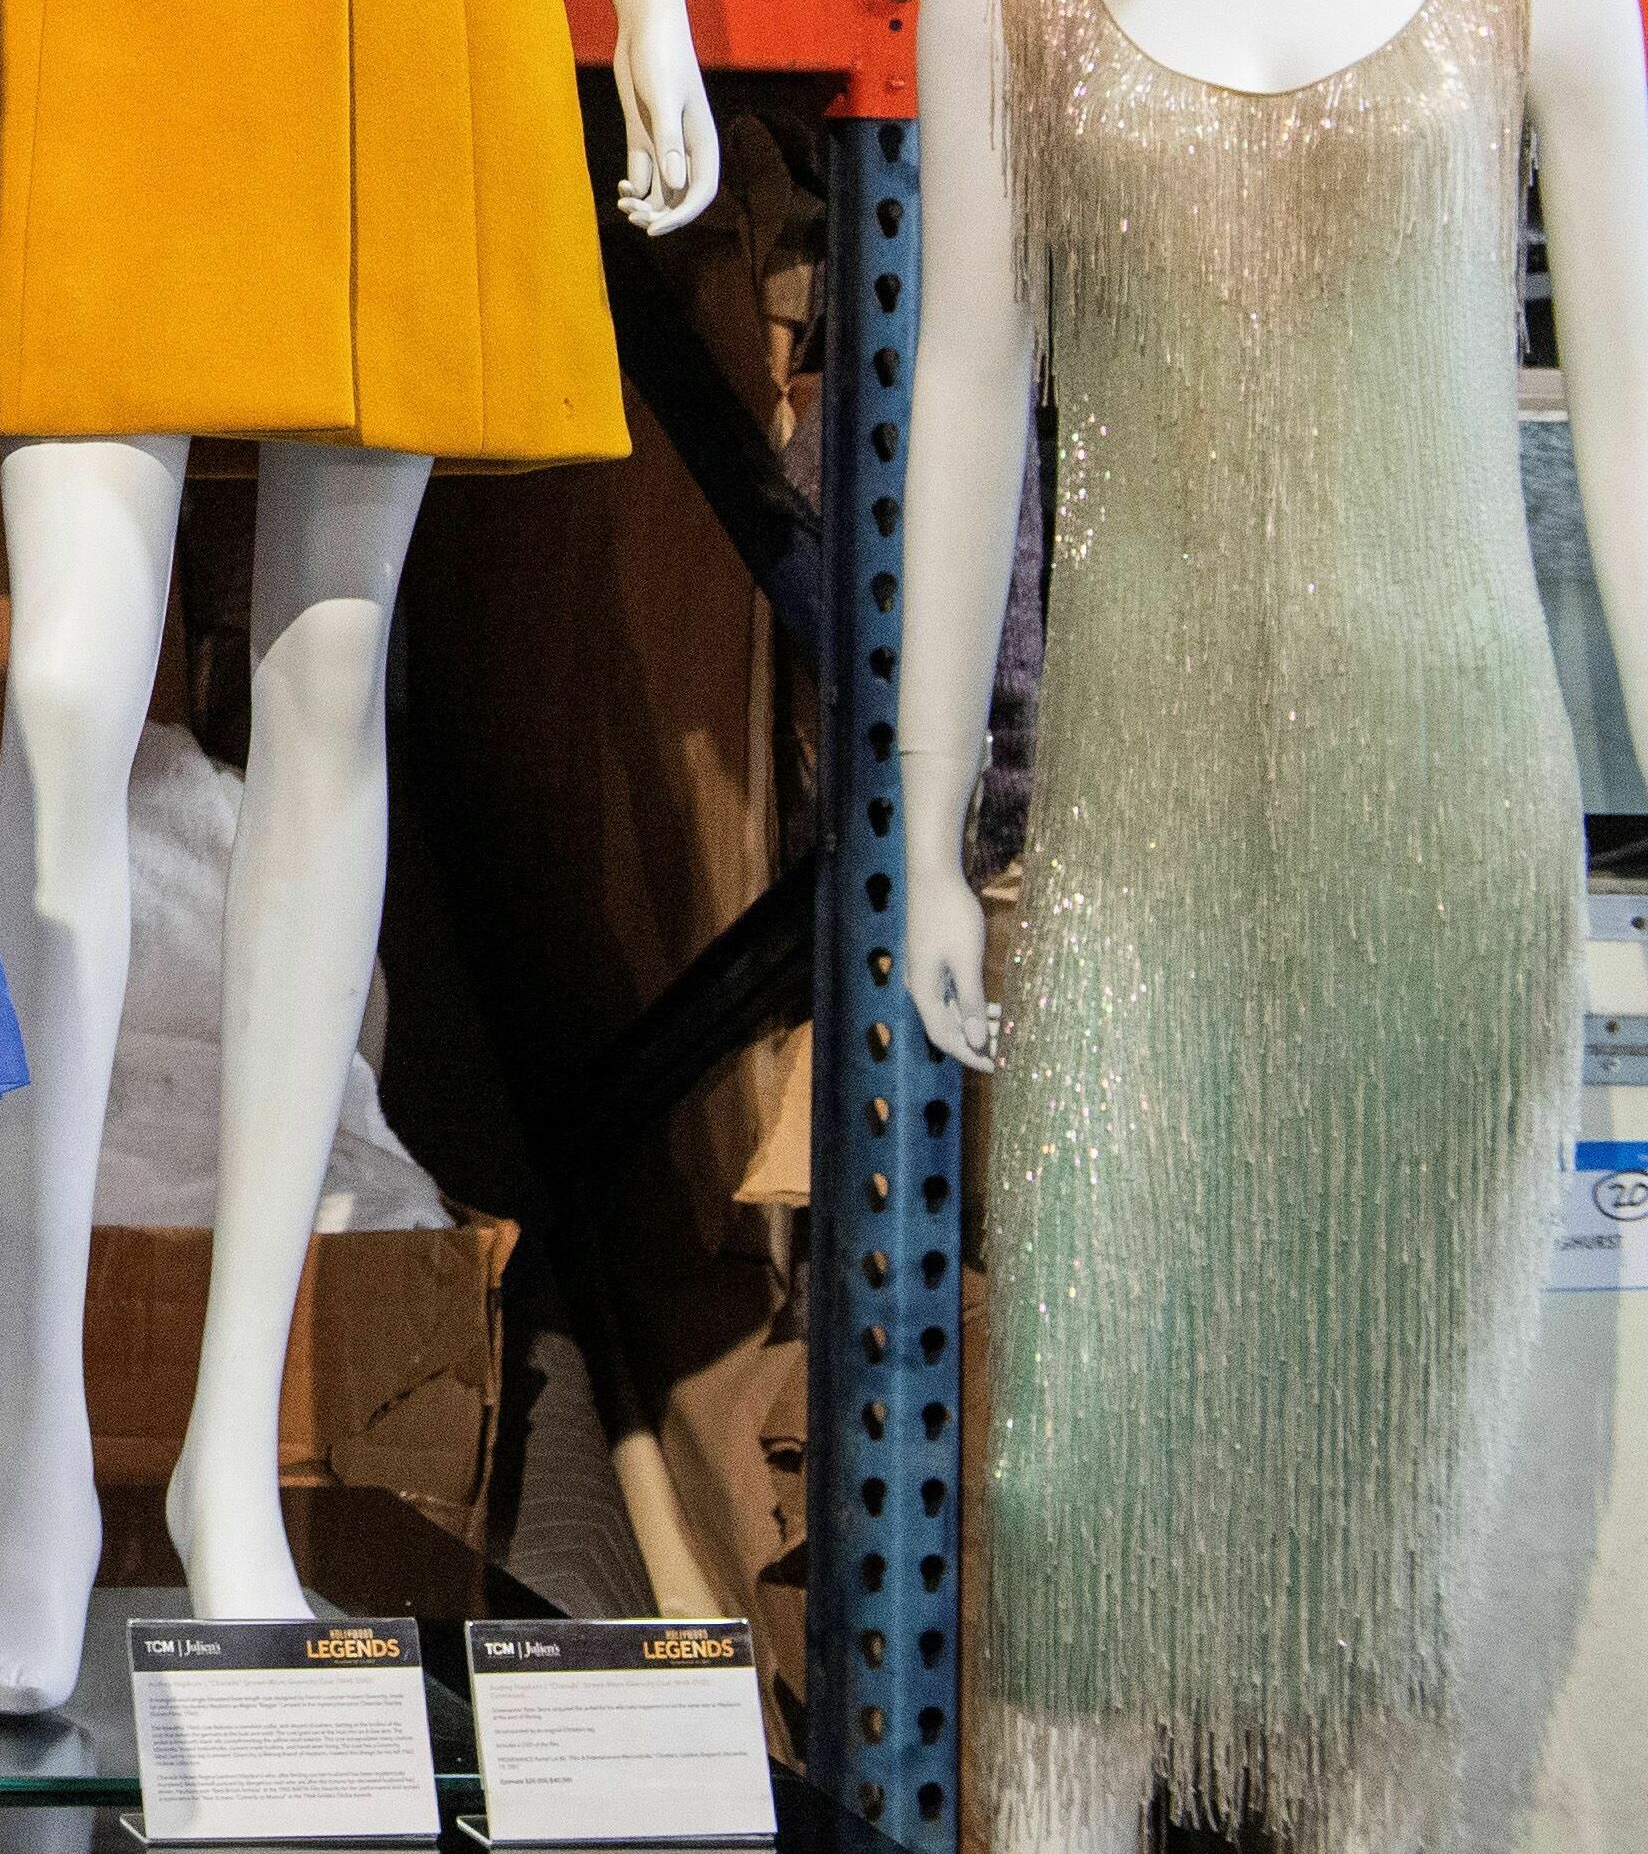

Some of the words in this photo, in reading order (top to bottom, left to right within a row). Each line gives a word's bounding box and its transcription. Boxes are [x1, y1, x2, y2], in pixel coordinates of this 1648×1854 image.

[144, 1640, 174, 1654] TCM
[306, 1637, 401, 1660] LEGENDS
[484, 1642, 514, 1656] TCM
[643, 1638, 735, 1660] LEGENDS
